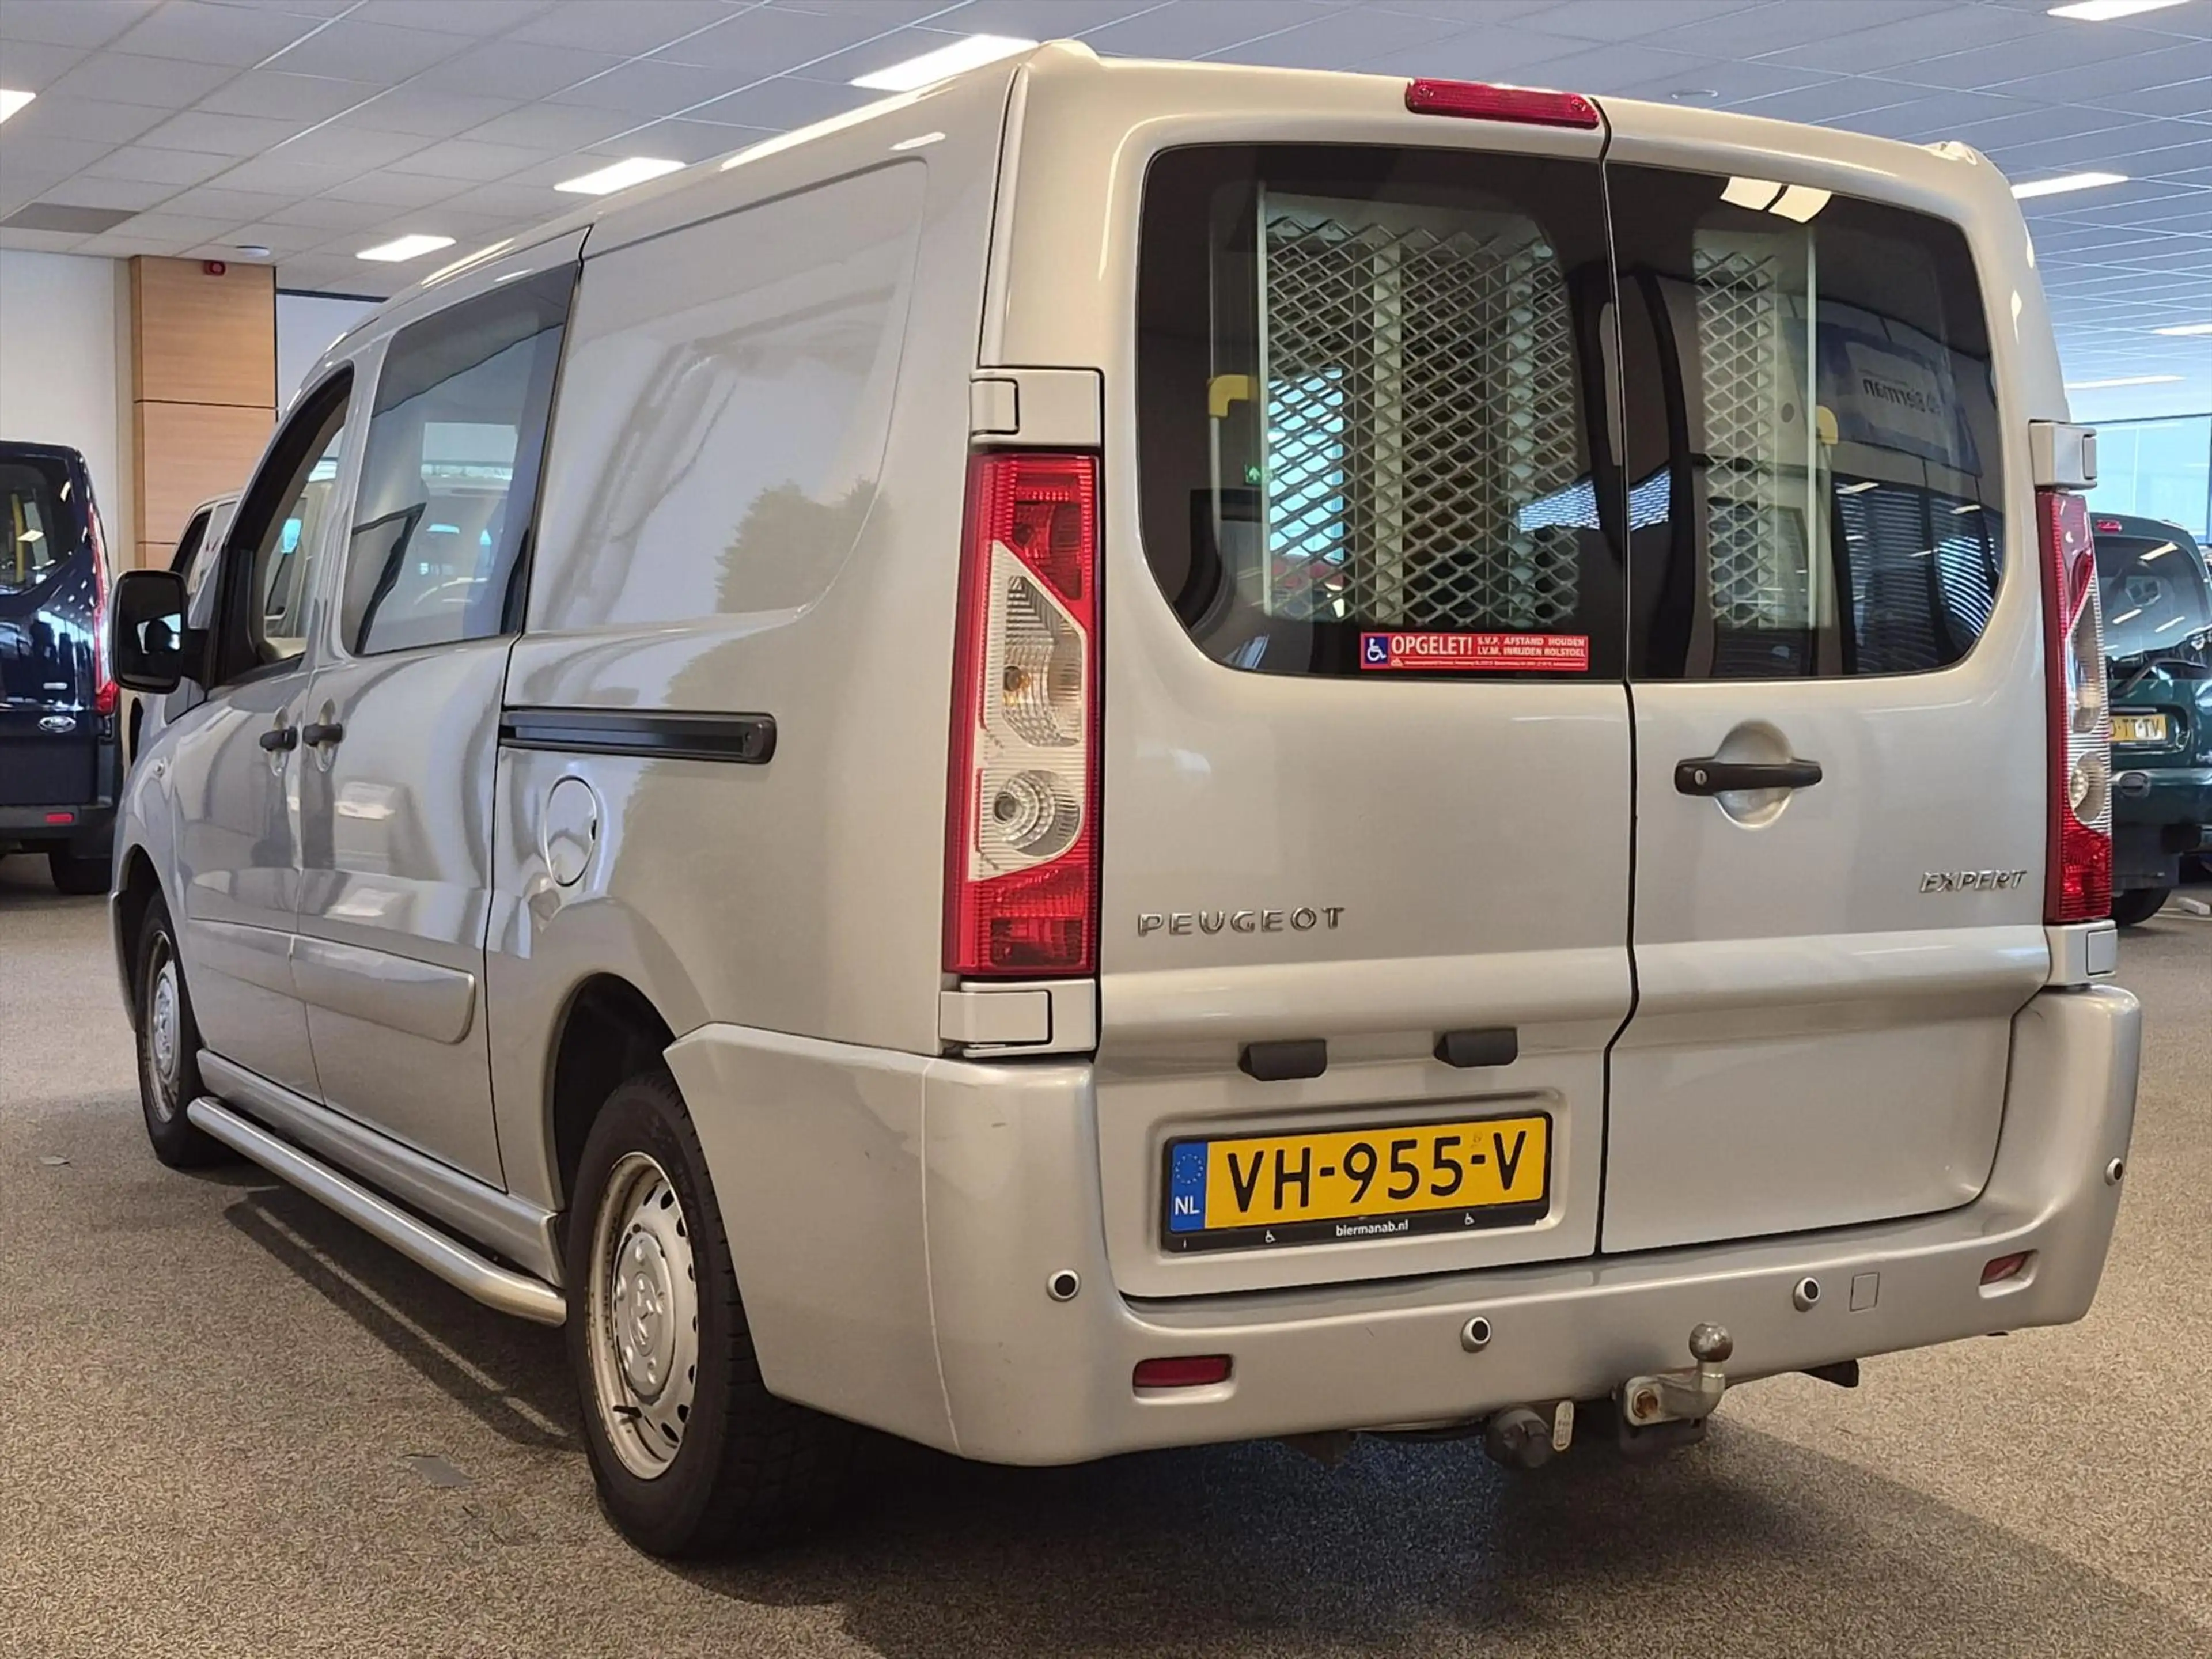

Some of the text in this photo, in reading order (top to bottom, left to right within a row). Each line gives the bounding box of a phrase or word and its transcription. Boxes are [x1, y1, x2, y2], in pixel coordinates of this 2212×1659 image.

[1391, 635, 1472, 655] OPGELET!
[1503, 637, 1544, 646] AFSTAND
[1548, 638, 1585, 646] HOUDEN
[1544, 647, 1586, 657] ROLSTOEL
[1919, 869, 2028, 893] EXPERT
[1138, 907, 1345, 937] PEUGEOT
[1175, 1130, 1527, 1216] NL VH-955-V
[1335, 1219, 1408, 1237] biermanab.nl
